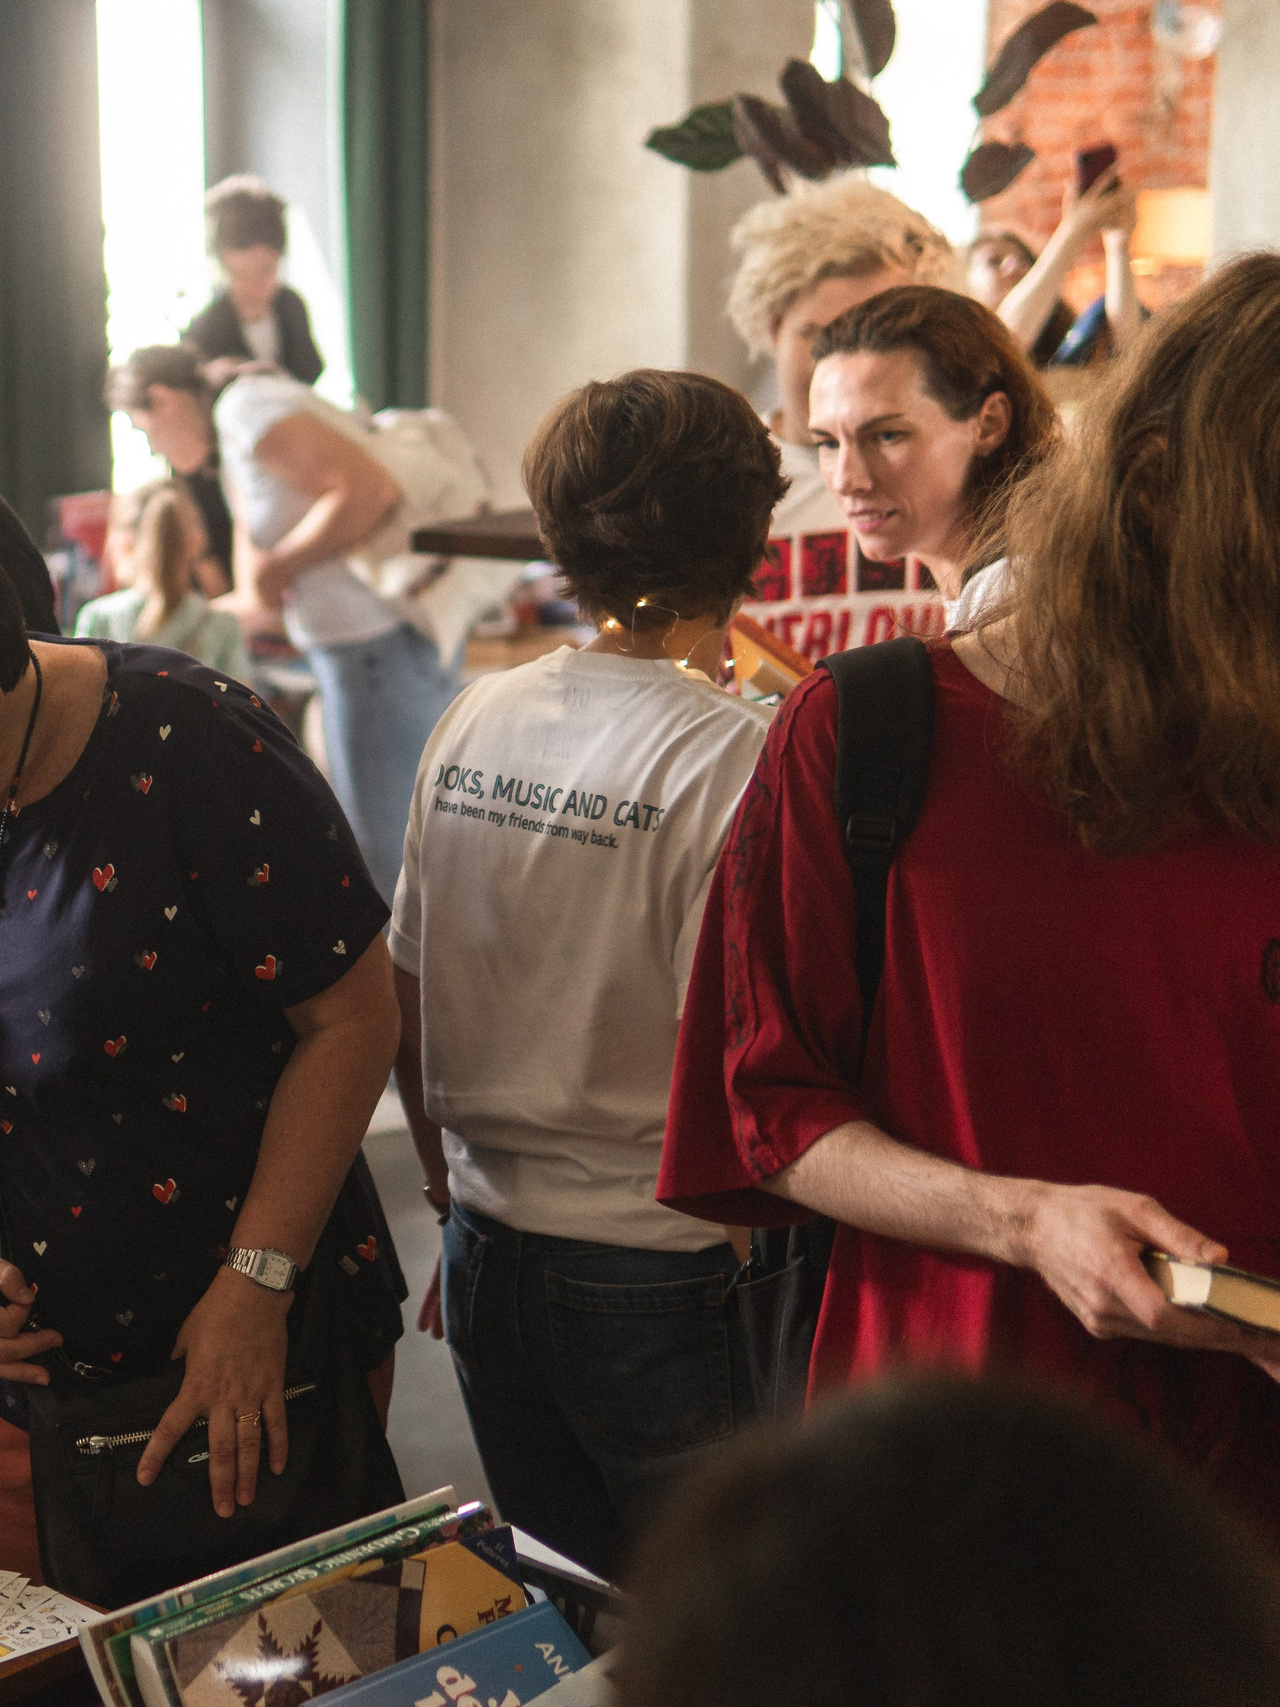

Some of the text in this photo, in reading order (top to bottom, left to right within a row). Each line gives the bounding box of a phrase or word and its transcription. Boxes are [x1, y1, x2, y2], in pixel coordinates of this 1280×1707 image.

[435, 797, 619, 849] have been my friends from way back.
[492, 774, 563, 813] MUSIC
[562, 789, 607, 820] AND
[614, 800, 665, 832] CATS
